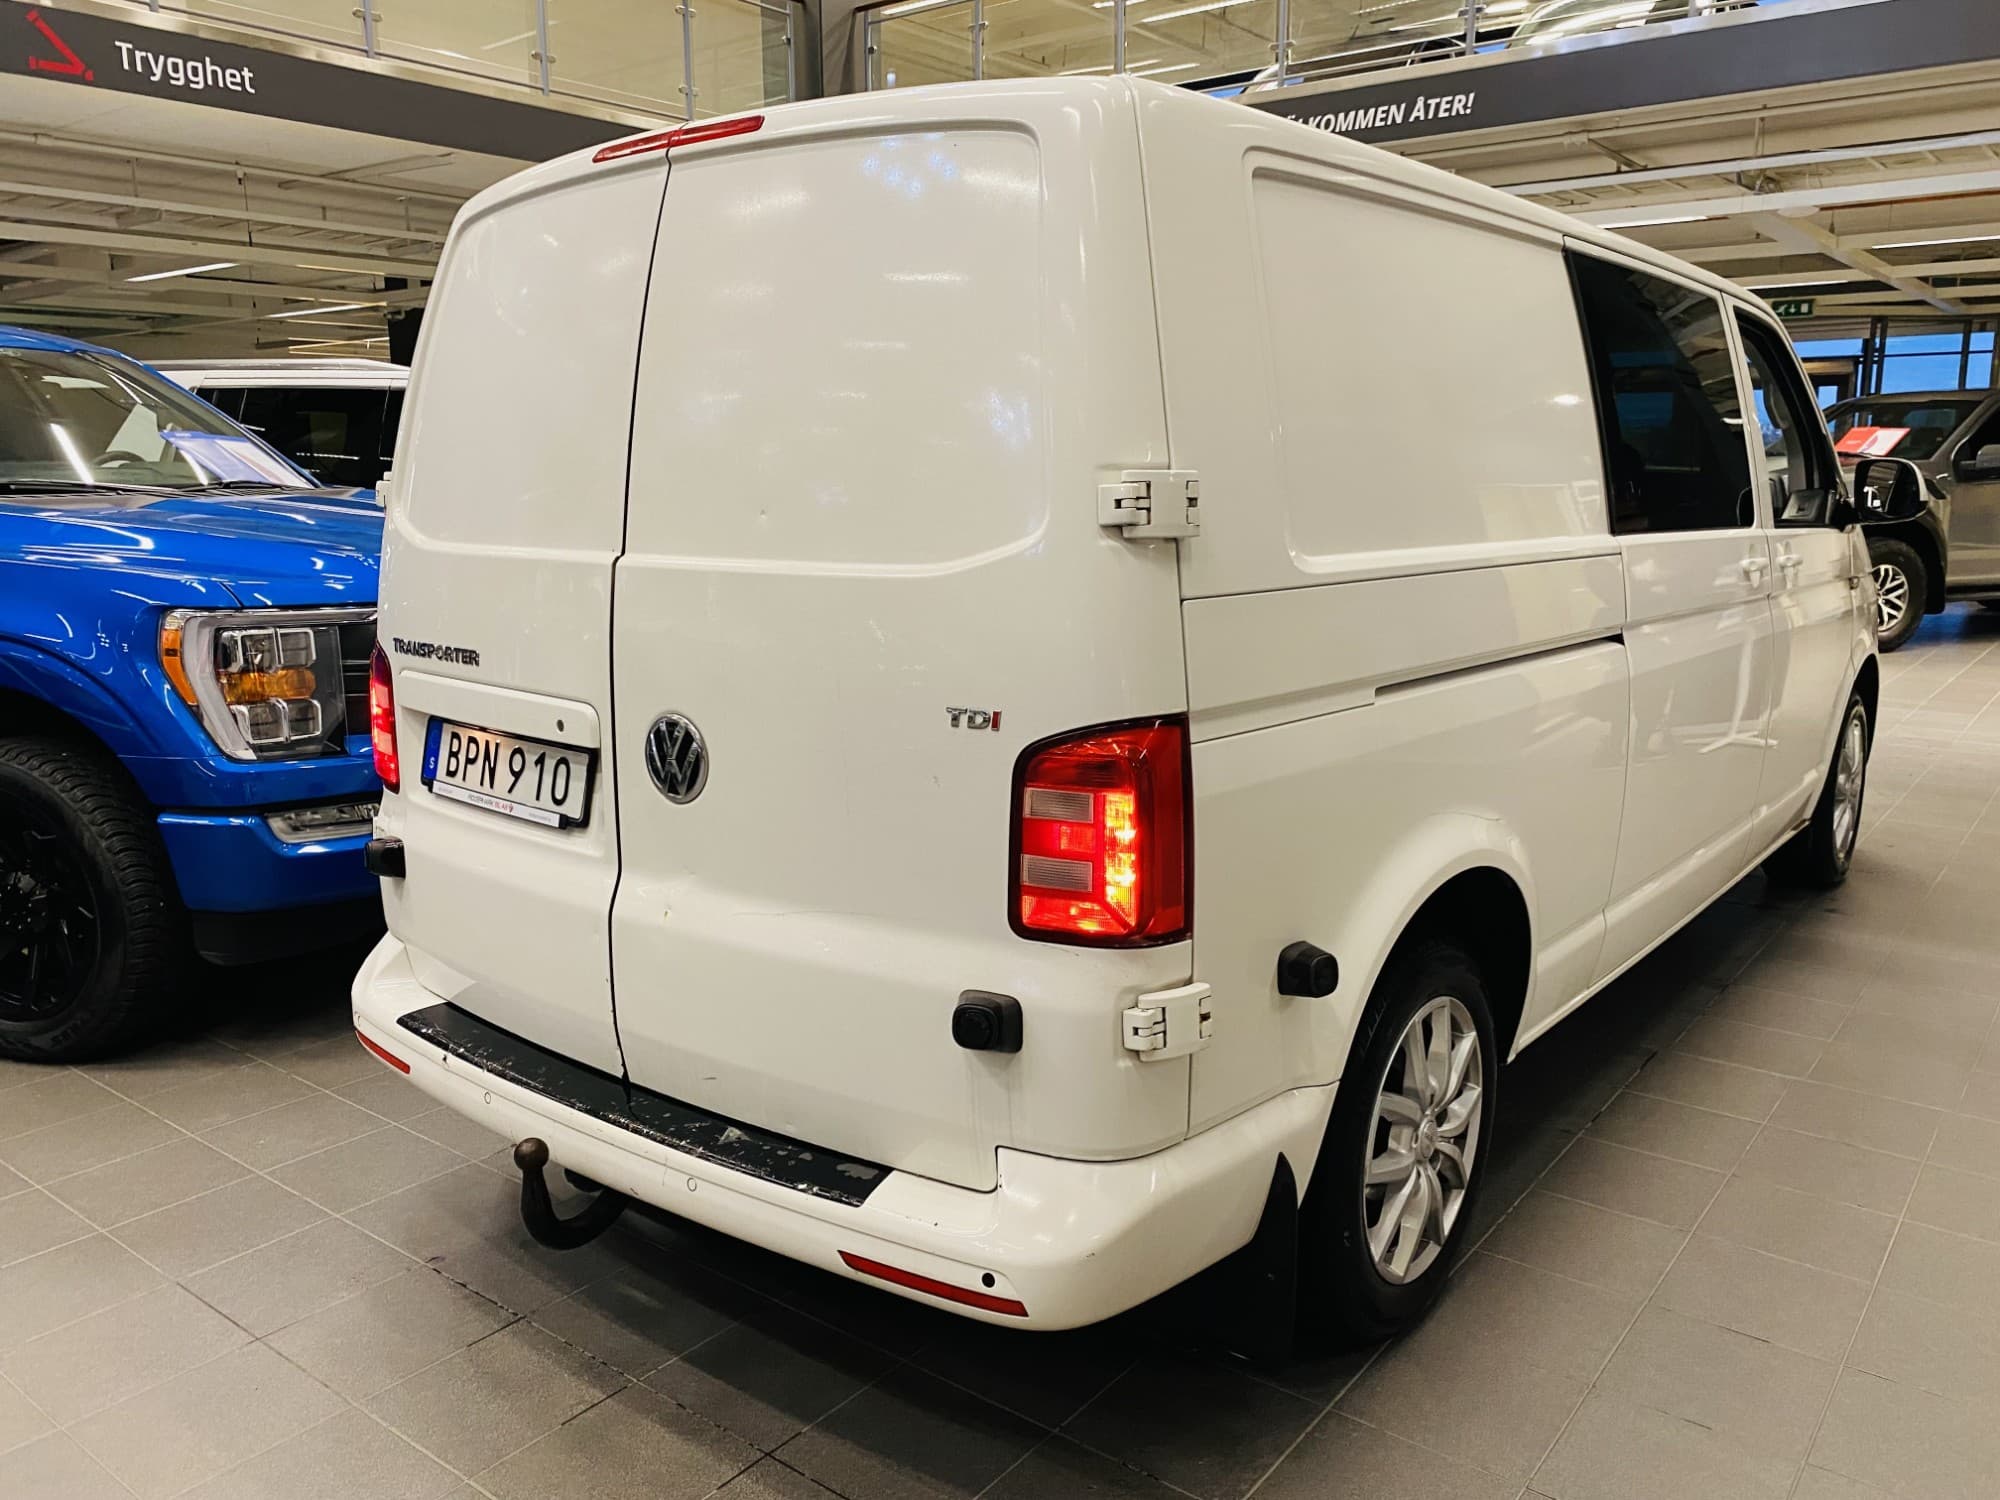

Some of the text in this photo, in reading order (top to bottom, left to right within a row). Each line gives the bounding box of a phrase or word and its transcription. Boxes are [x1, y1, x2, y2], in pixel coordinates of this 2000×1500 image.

[114, 40, 256, 94] Trygghet
[1408, 92, 1475, 122] ÅTER!
[393, 637, 480, 667] TRANSPORTER
[945, 706, 1002, 732] TDI
[445, 731, 571, 806] BPN 910
[647, 716, 707, 802] VW
